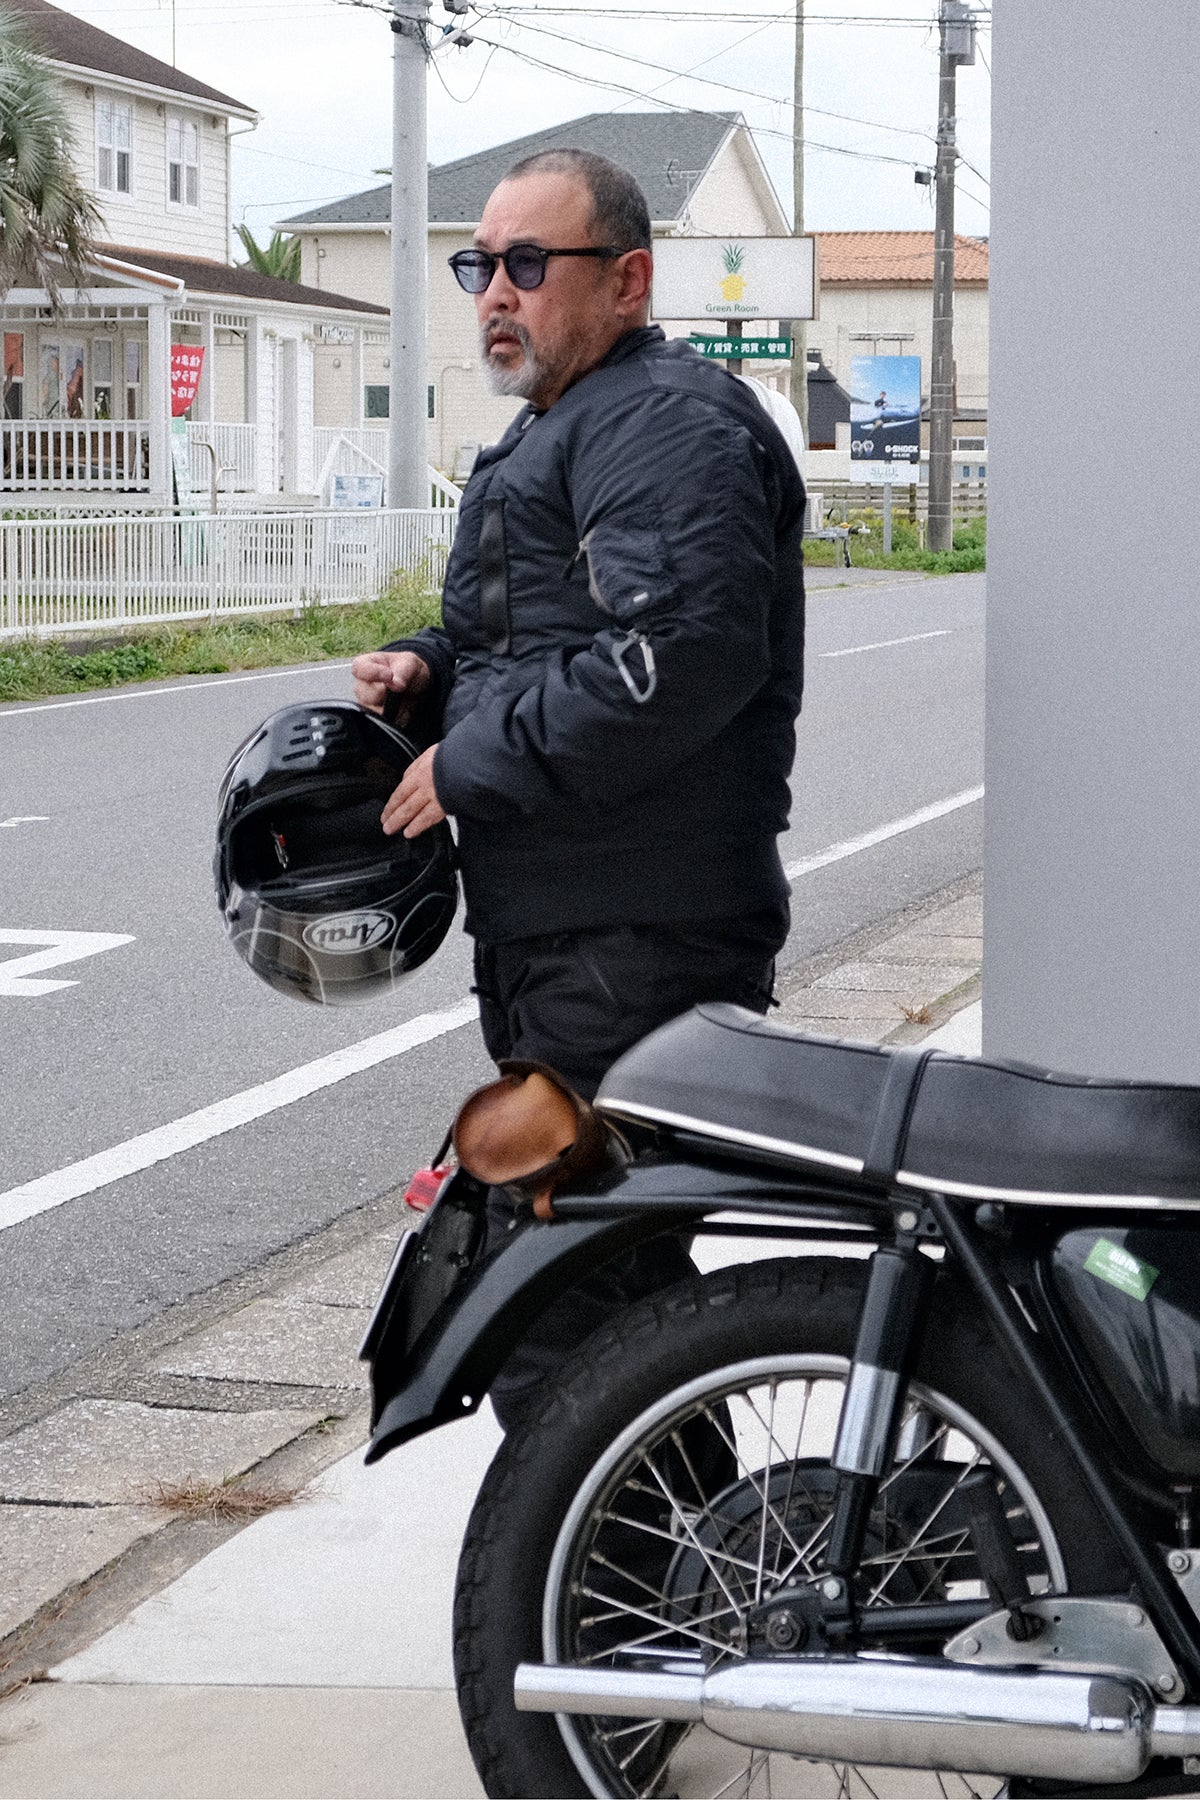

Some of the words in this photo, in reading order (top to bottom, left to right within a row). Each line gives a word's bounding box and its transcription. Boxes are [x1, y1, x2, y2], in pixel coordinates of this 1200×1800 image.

[705, 303, 732, 313] Green
[734, 303, 760, 313] Room
[316, 917, 388, 948] Arai
